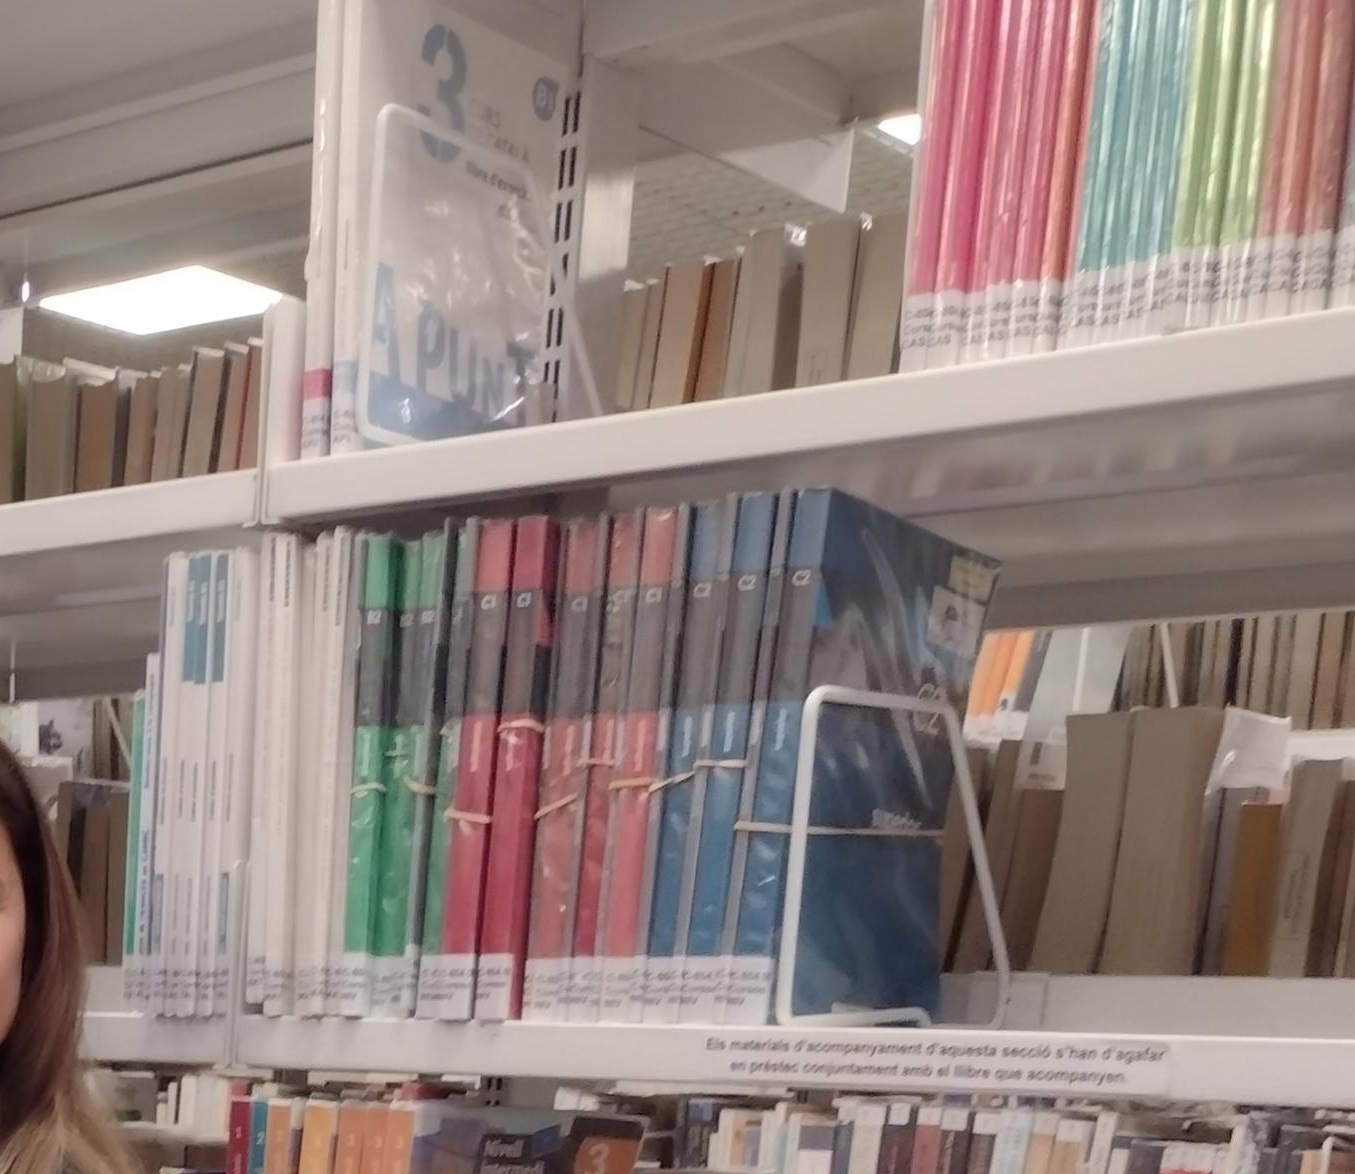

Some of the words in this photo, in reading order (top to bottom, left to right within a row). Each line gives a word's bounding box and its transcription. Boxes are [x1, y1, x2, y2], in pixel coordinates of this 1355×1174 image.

[417, 24, 467, 164] 3
[737, 574, 757, 591] C2
[791, 570, 811, 586] C2
[706, 1037, 725, 1050] Els
[729, 1038, 789, 1051] materials
[795, 1039, 923, 1057] d'acompanyament
[730, 1062, 744, 1072] en
[803, 1062, 898, 1077] conjuntament
[902, 1063, 933, 1077] amb
[937, 1065, 950, 1077] el
[954, 1065, 990, 1079] llibre
[995, 1068, 1022, 1081] que
[256, 1131, 265, 1145] 2
[484, 1139, 524, 1158] Nivell
